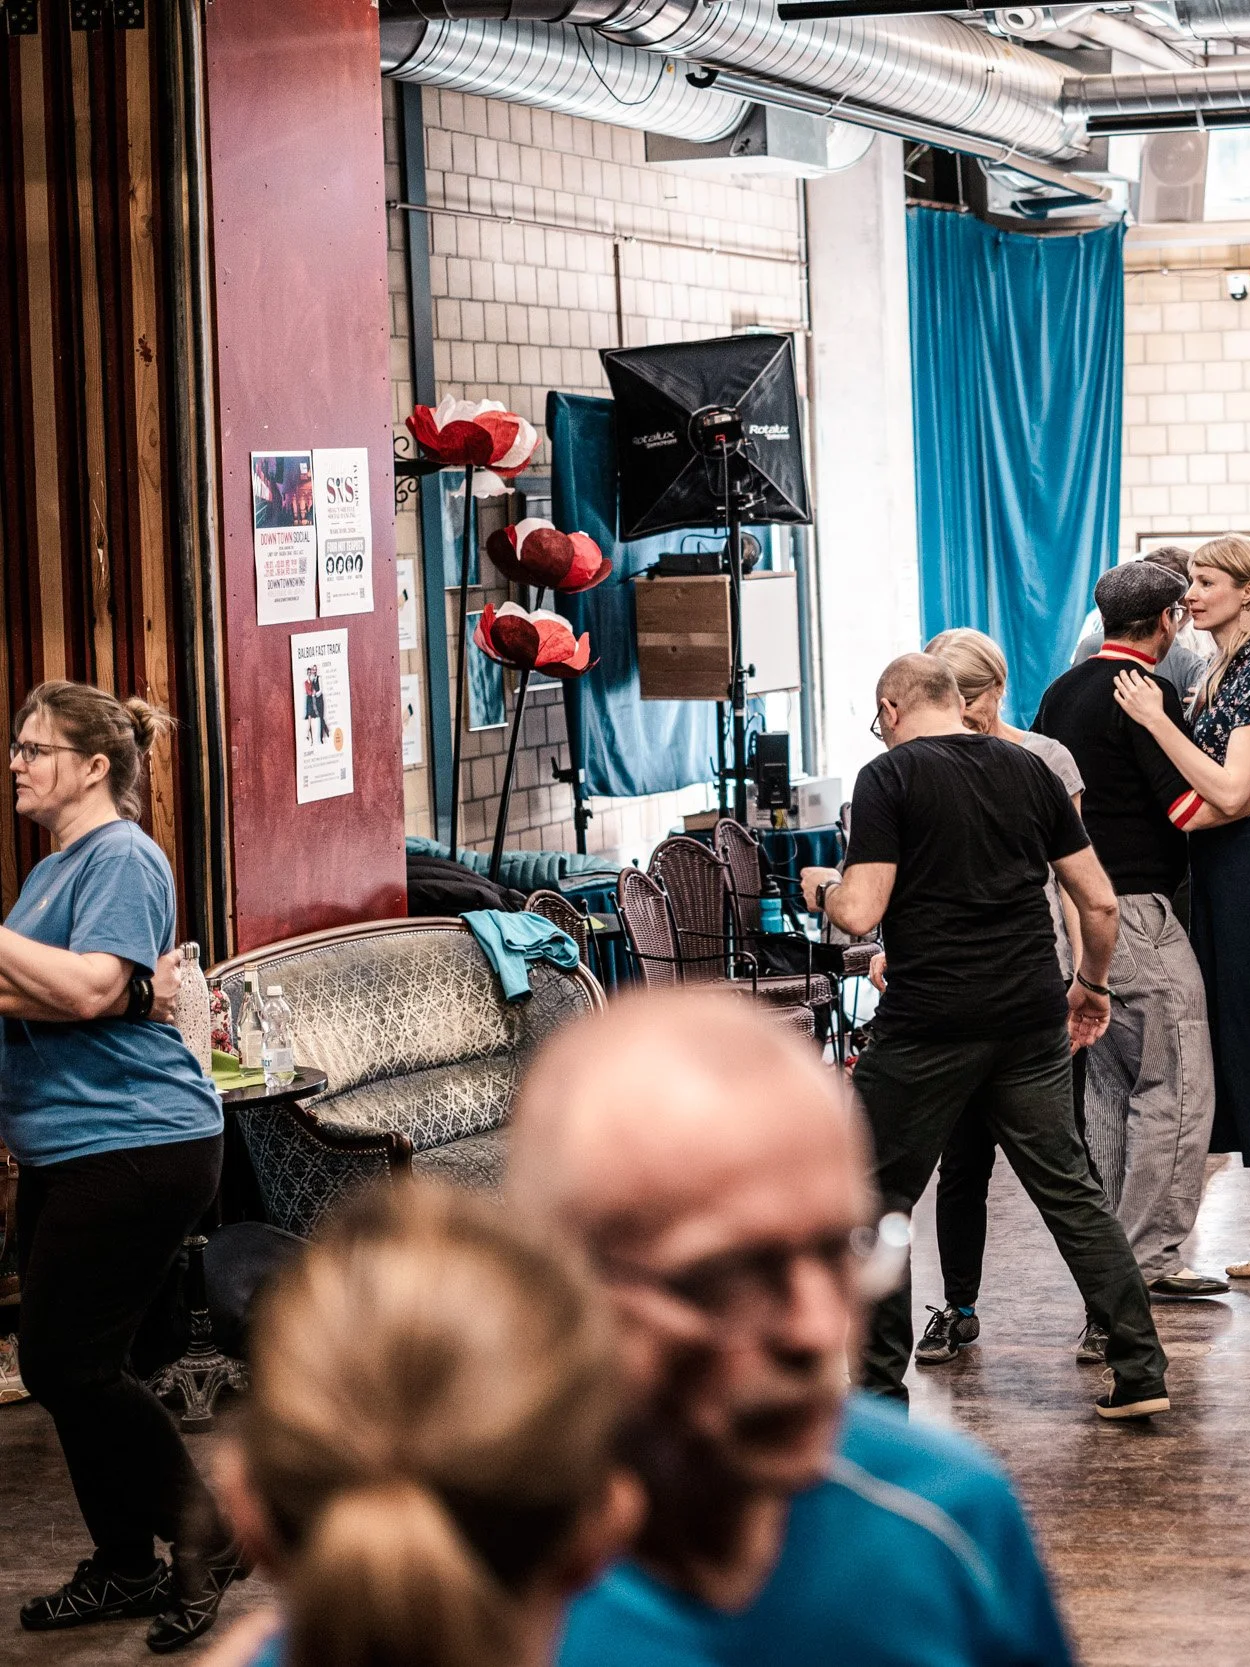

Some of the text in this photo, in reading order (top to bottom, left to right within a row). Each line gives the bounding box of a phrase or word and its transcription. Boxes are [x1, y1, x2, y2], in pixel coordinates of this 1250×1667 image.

[749, 424, 789, 435] Rotalux
[293, 531, 310, 543] SOCIAL
[297, 643, 341, 660] BALBOA FAST TRACK
